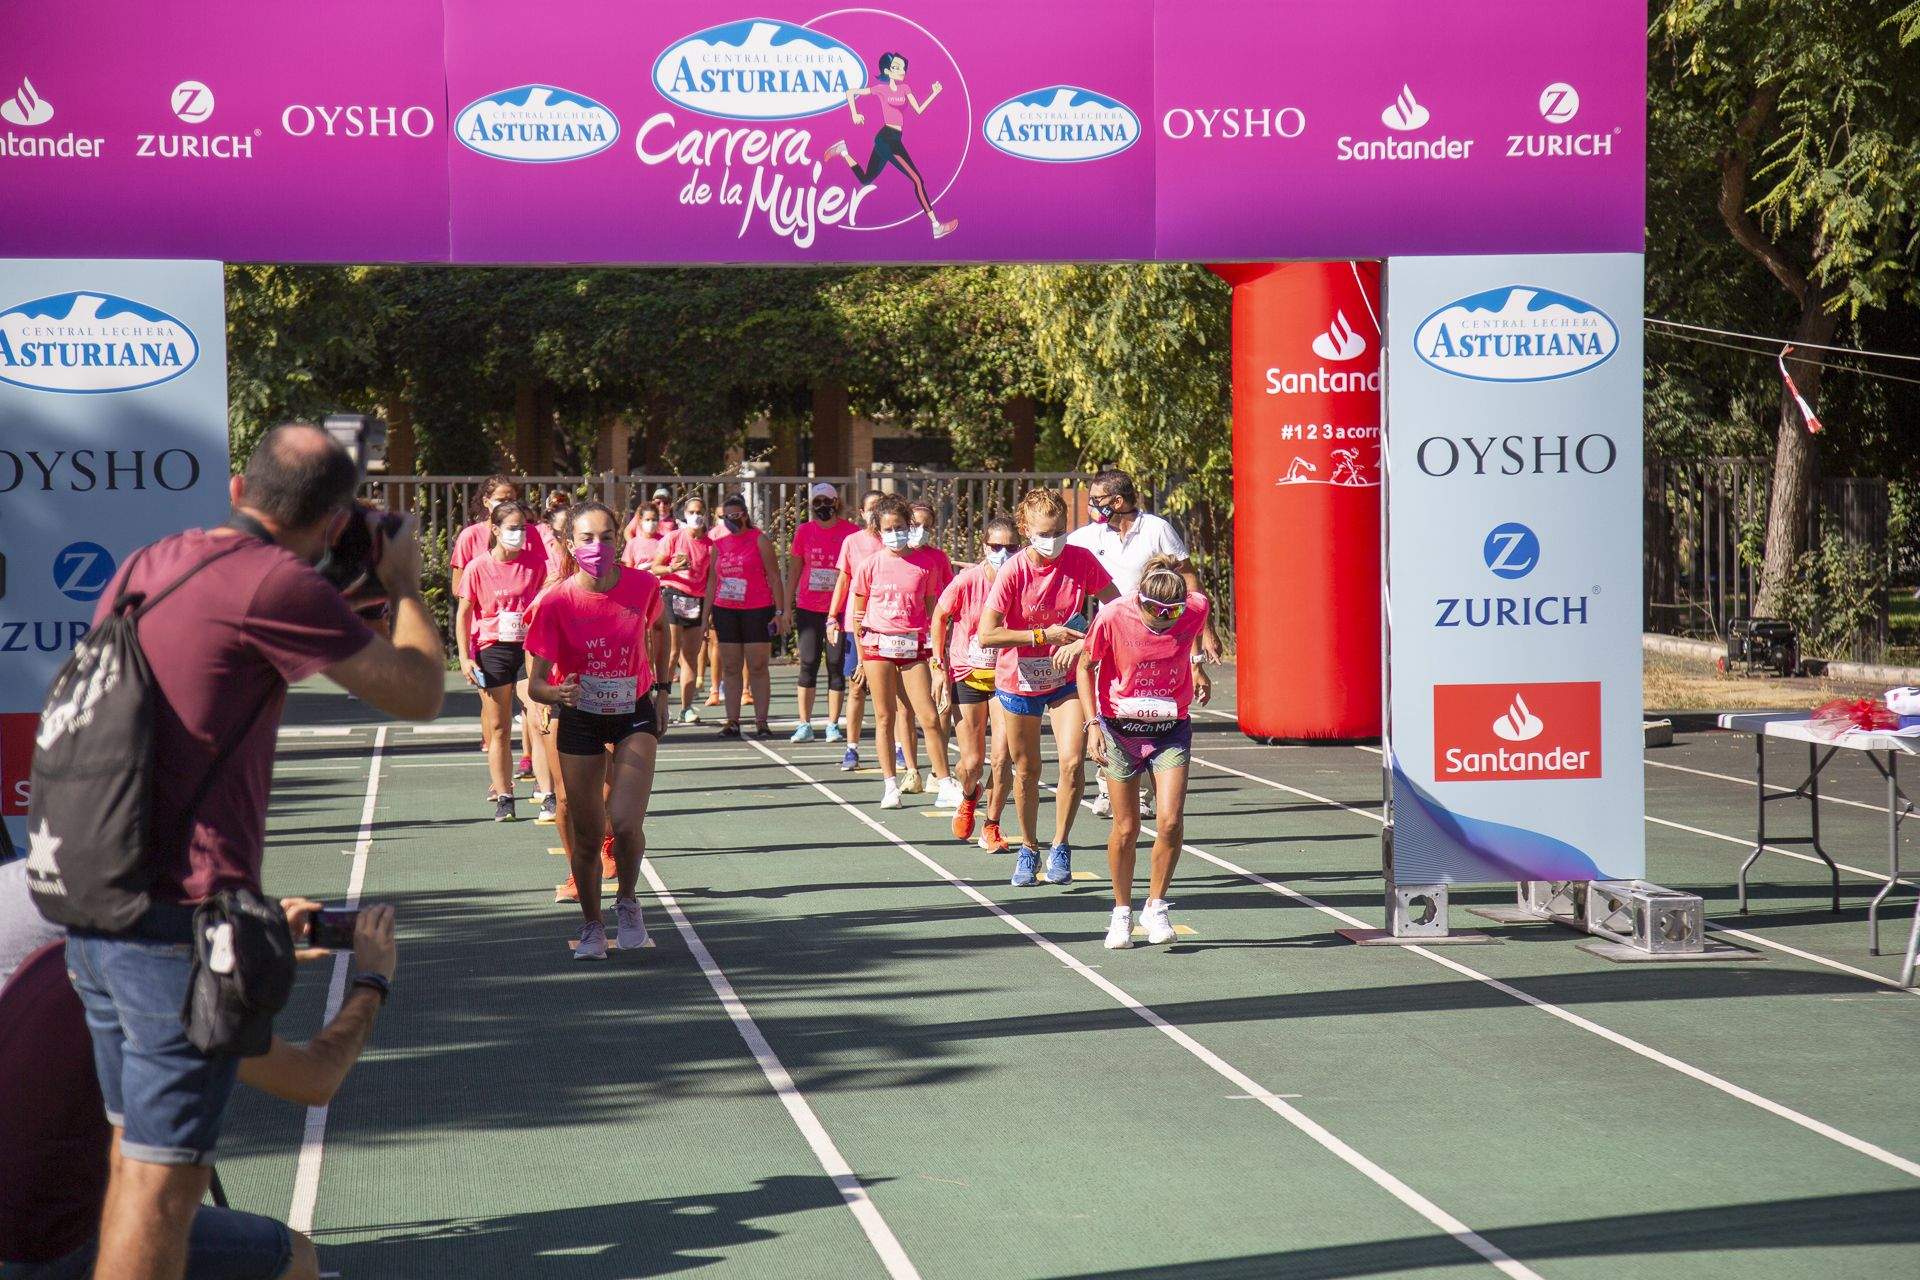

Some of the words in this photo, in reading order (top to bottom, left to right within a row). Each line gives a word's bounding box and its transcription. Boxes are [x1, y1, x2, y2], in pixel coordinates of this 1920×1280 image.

[702, 53, 769, 63] CENTRAL
[777, 53, 845, 63] LECHERA
[670, 56, 850, 93] ASTURIANA
[281, 104, 435, 138] OYSHO
[469, 112, 607, 142] ASTURIANA
[996, 114, 1129, 142] ASTURIANA
[1163, 107, 1306, 139] OYSHO
[136, 134, 253, 158] ZURICH
[635, 112, 812, 167] Carrera
[1337, 135, 1474, 160] Santander
[1506, 134, 1612, 157] ZURICH
[679, 167, 713, 205] de
[719, 167, 743, 205] la
[737, 160, 878, 249] Mujer
[22, 326, 94, 337] CENTRAL
[102, 326, 176, 336] LECHERA
[1461, 319, 1526, 329] CENTRAL
[1533, 318, 1598, 328] LECHERA
[1430, 322, 1604, 358] ASTURIANA
[1347, 427, 1381, 439] corr
[1416, 433, 1617, 477] OYSHO
[1028, 603, 1045, 612] WE
[1435, 596, 1588, 627] ZURICH
[586, 638, 606, 649] WE
[981, 647, 998, 655] 016
[588, 661, 608, 670] FOR
[620, 658, 628, 666] A
[1033, 668, 1052, 677] 016
[1137, 661, 1156, 669] WE
[1135, 678, 1155, 687] FOR
[597, 690, 619, 699] 016
[1137, 709, 1159, 718] 016
[1446, 747, 1591, 773] Santander
